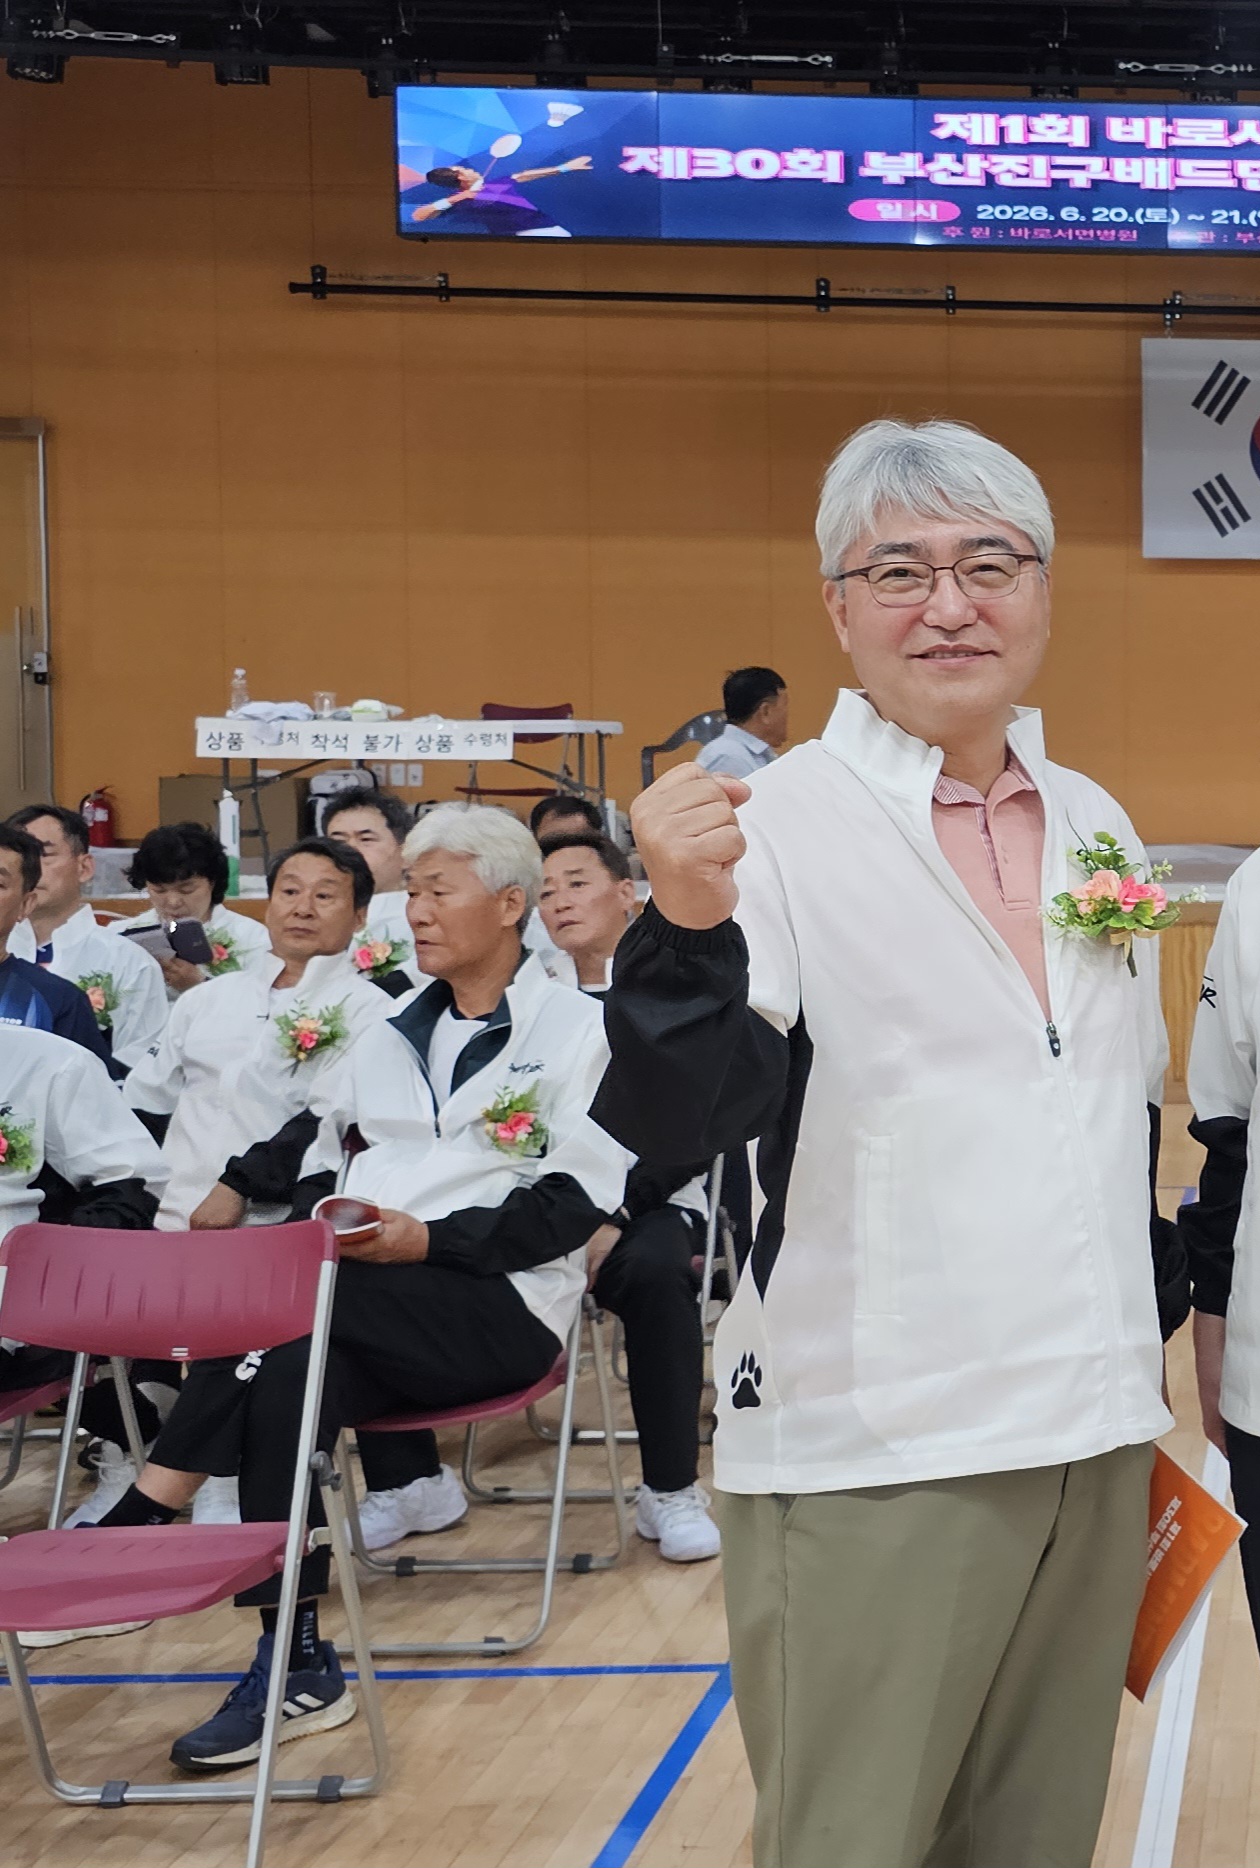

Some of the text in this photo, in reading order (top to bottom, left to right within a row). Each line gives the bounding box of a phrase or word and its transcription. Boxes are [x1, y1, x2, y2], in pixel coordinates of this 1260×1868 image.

[930, 112, 1090, 148] 제1회
[618, 145, 845, 184] 제30회
[976, 204, 1055, 221] 2026.
[1009, 227, 1139, 242] 바로서면병원
[206, 731, 245, 751] 상품
[311, 733, 349, 752] 착석
[363, 734, 403, 752] 불가
[415, 733, 454, 753] 상품
[464, 732, 508, 747] 수령처
